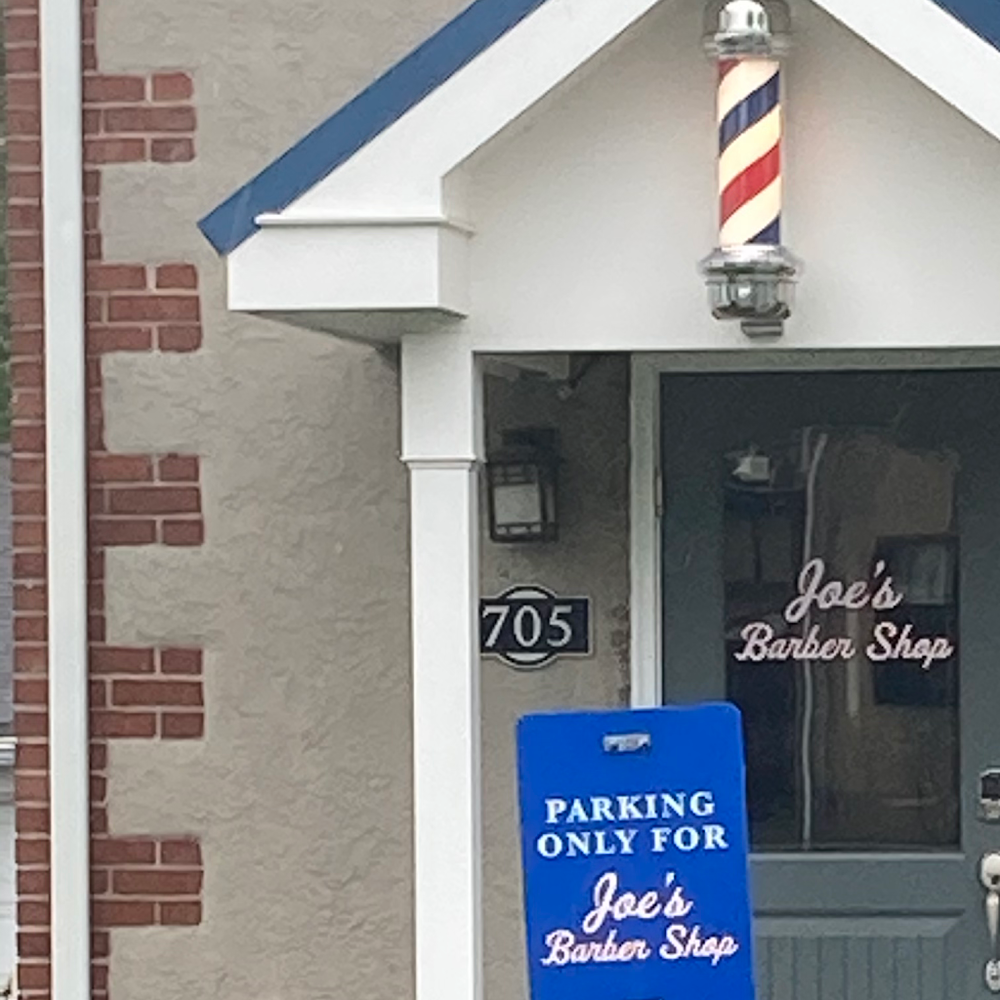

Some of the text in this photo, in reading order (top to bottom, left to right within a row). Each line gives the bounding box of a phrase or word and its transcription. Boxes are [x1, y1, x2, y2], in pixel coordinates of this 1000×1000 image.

[785, 558, 903, 623] Joe's
[482, 604, 572, 647] 705
[734, 622, 953, 669] Barber Shop
[545, 791, 715, 823] PARKING
[537, 824, 729, 858] ONLY FOR
[582, 872, 693, 934] Joe's
[541, 925, 739, 965] Barber Shop
